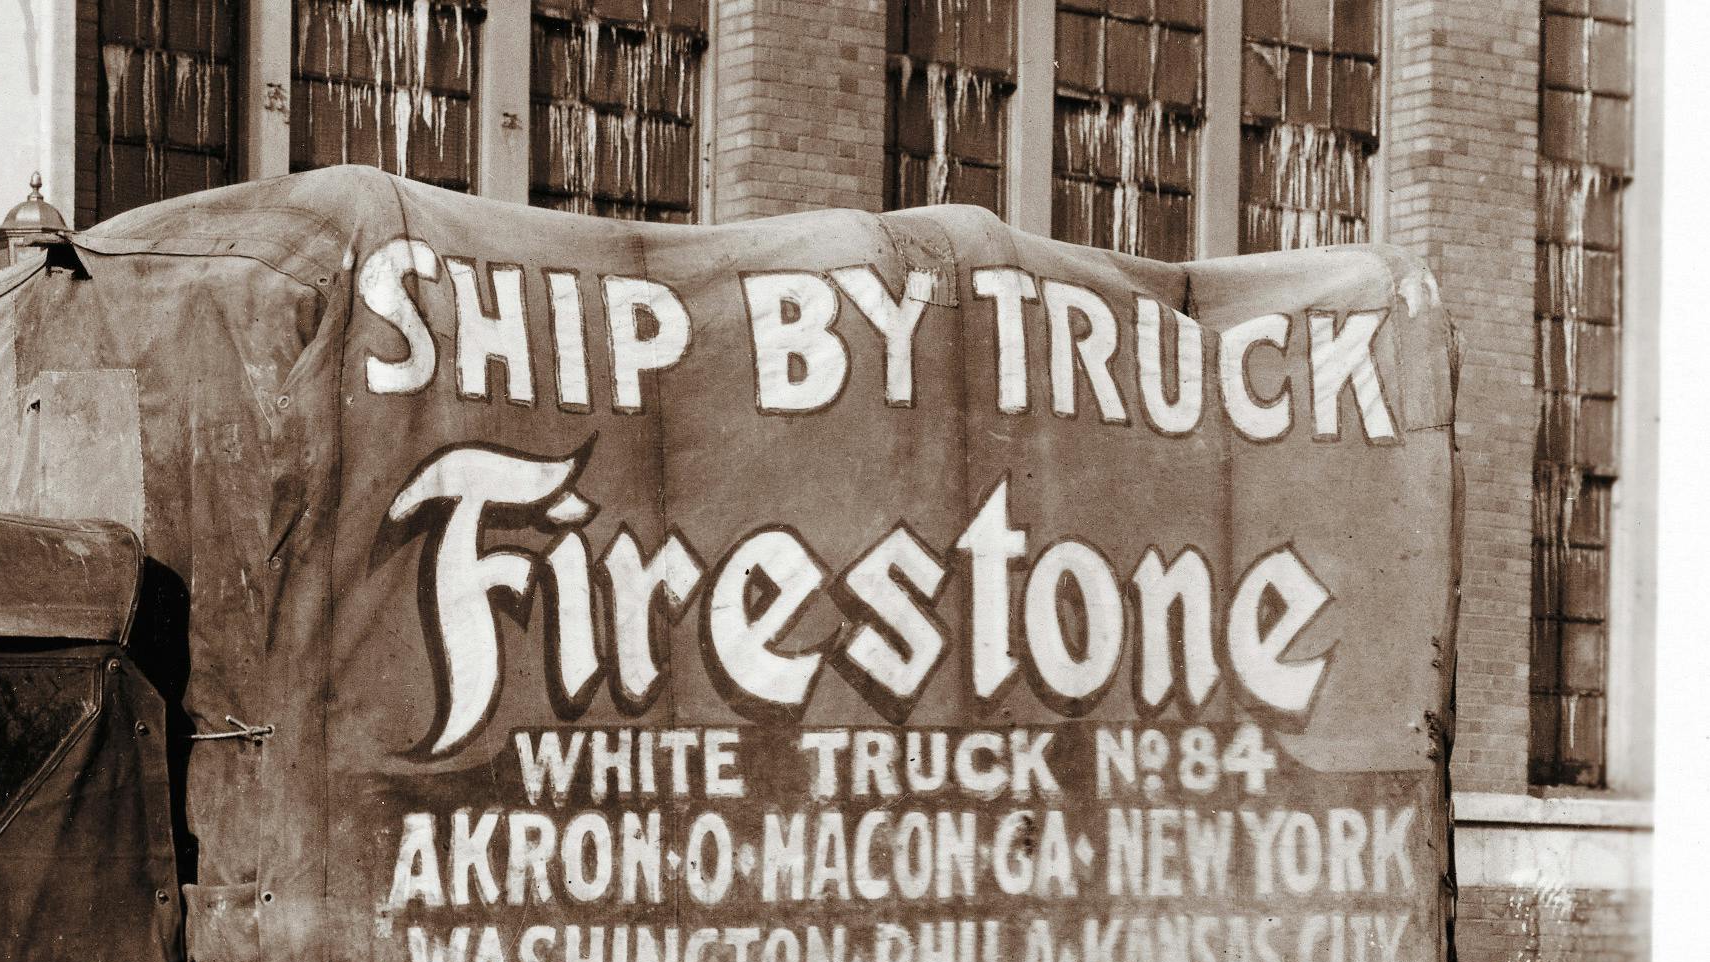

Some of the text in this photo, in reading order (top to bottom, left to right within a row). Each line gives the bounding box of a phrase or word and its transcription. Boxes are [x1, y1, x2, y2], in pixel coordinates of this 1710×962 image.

[356, 236, 691, 414] SHIP
[739, 262, 939, 415] BY
[370, 433, 1336, 758] Firestone
[514, 727, 745, 806] WHITE
[801, 728, 1060, 800] TRUCK
[1107, 807, 1234, 896] NEW
[1241, 807, 1416, 896] YORK
